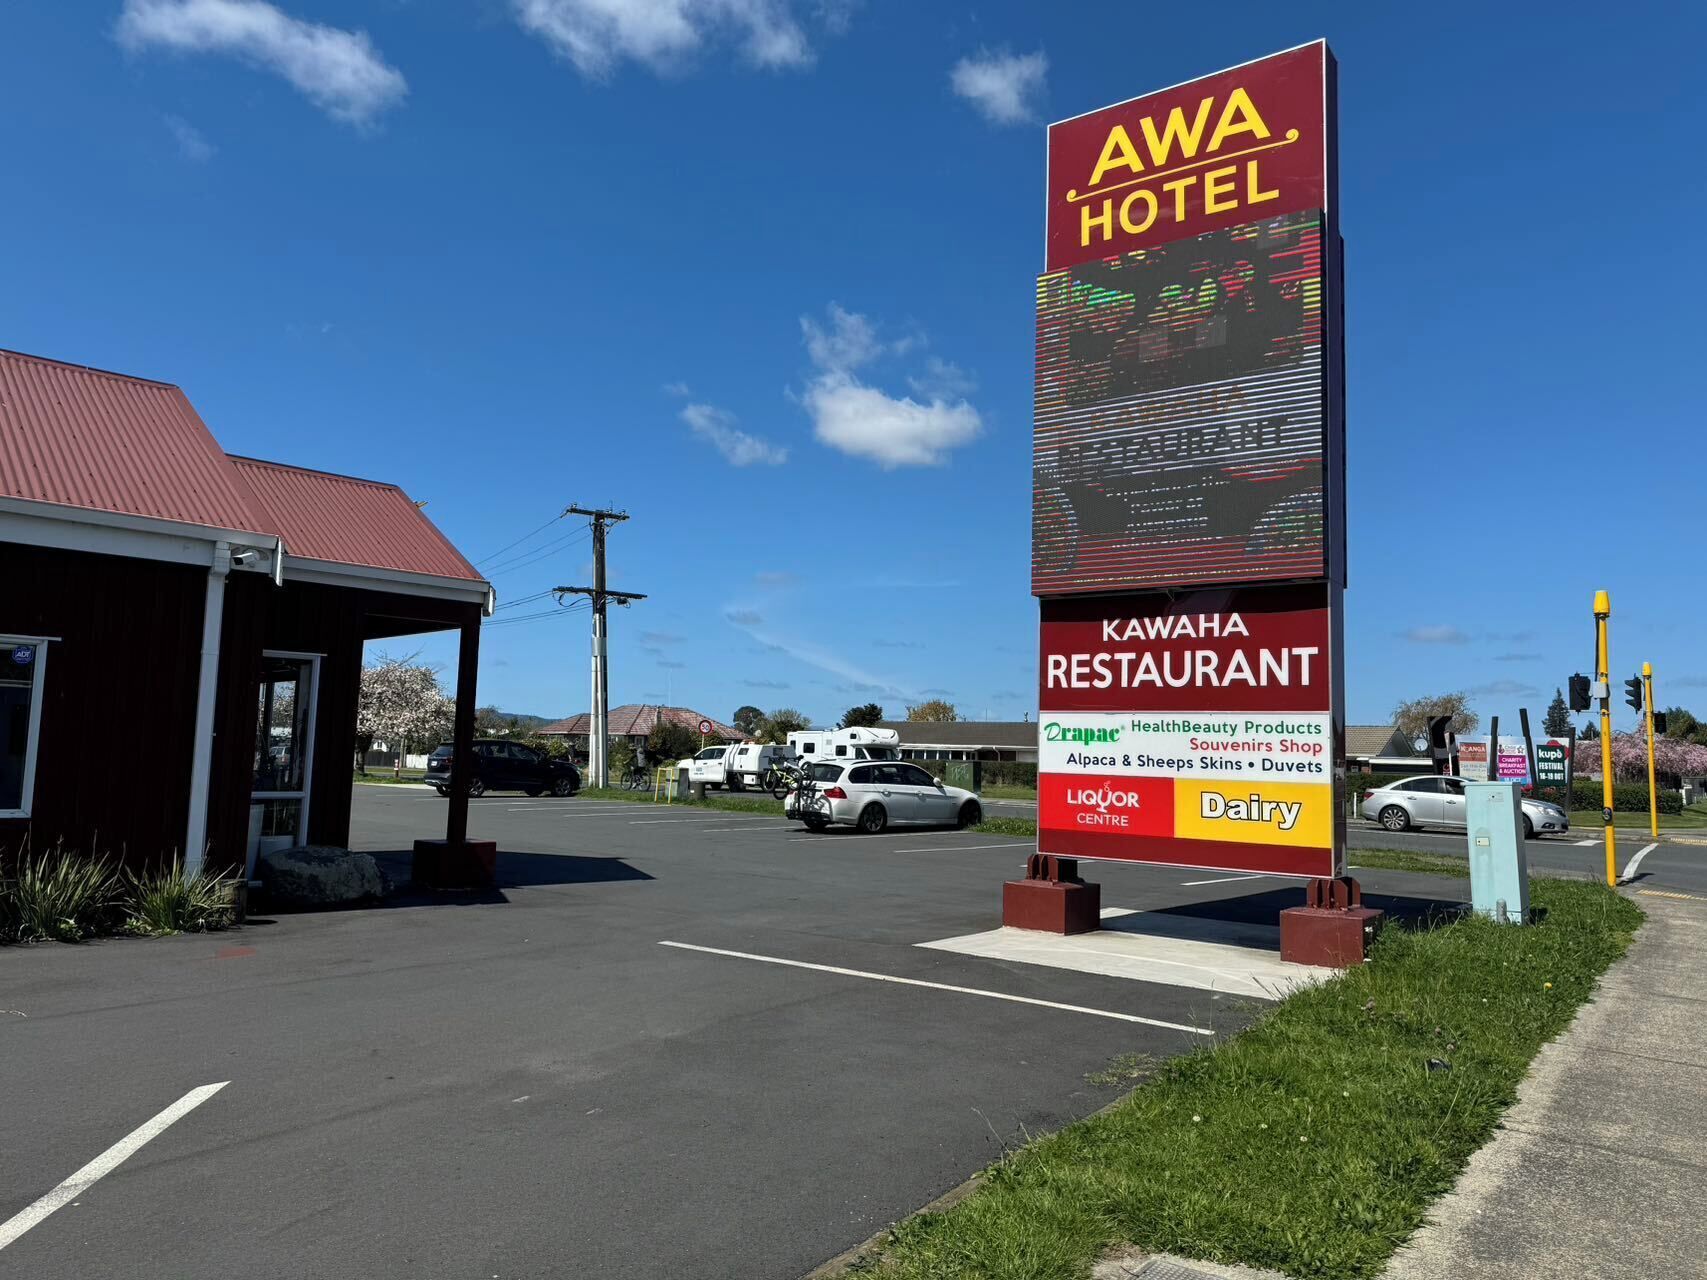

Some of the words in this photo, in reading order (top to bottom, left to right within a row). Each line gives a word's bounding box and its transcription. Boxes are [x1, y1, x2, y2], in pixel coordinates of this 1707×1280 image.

[1088, 87, 1271, 186] AWA
[1081, 160, 1279, 247] HOTEL
[1102, 612, 1249, 641] KAWAHA
[1047, 646, 1318, 689] RESTAURANT
[1043, 722, 1120, 746] Drapac
[1131, 719, 1238, 737] HealthBeauty
[1244, 720, 1322, 735] Products
[1189, 737, 1273, 753] Souvenirs
[1279, 738, 1323, 757] Shop
[1066, 752, 1117, 768] Alpaca
[1122, 754, 1132, 767] &
[1137, 754, 1194, 772] Sheeps
[1200, 756, 1243, 771] Skins
[1261, 758, 1323, 773] Duvets
[1538, 762, 1564, 770] FESTIVAL
[1066, 788, 1140, 808] LIQUOR
[1076, 812, 1129, 827] CENTRE
[1200, 791, 1302, 830] Dairy
